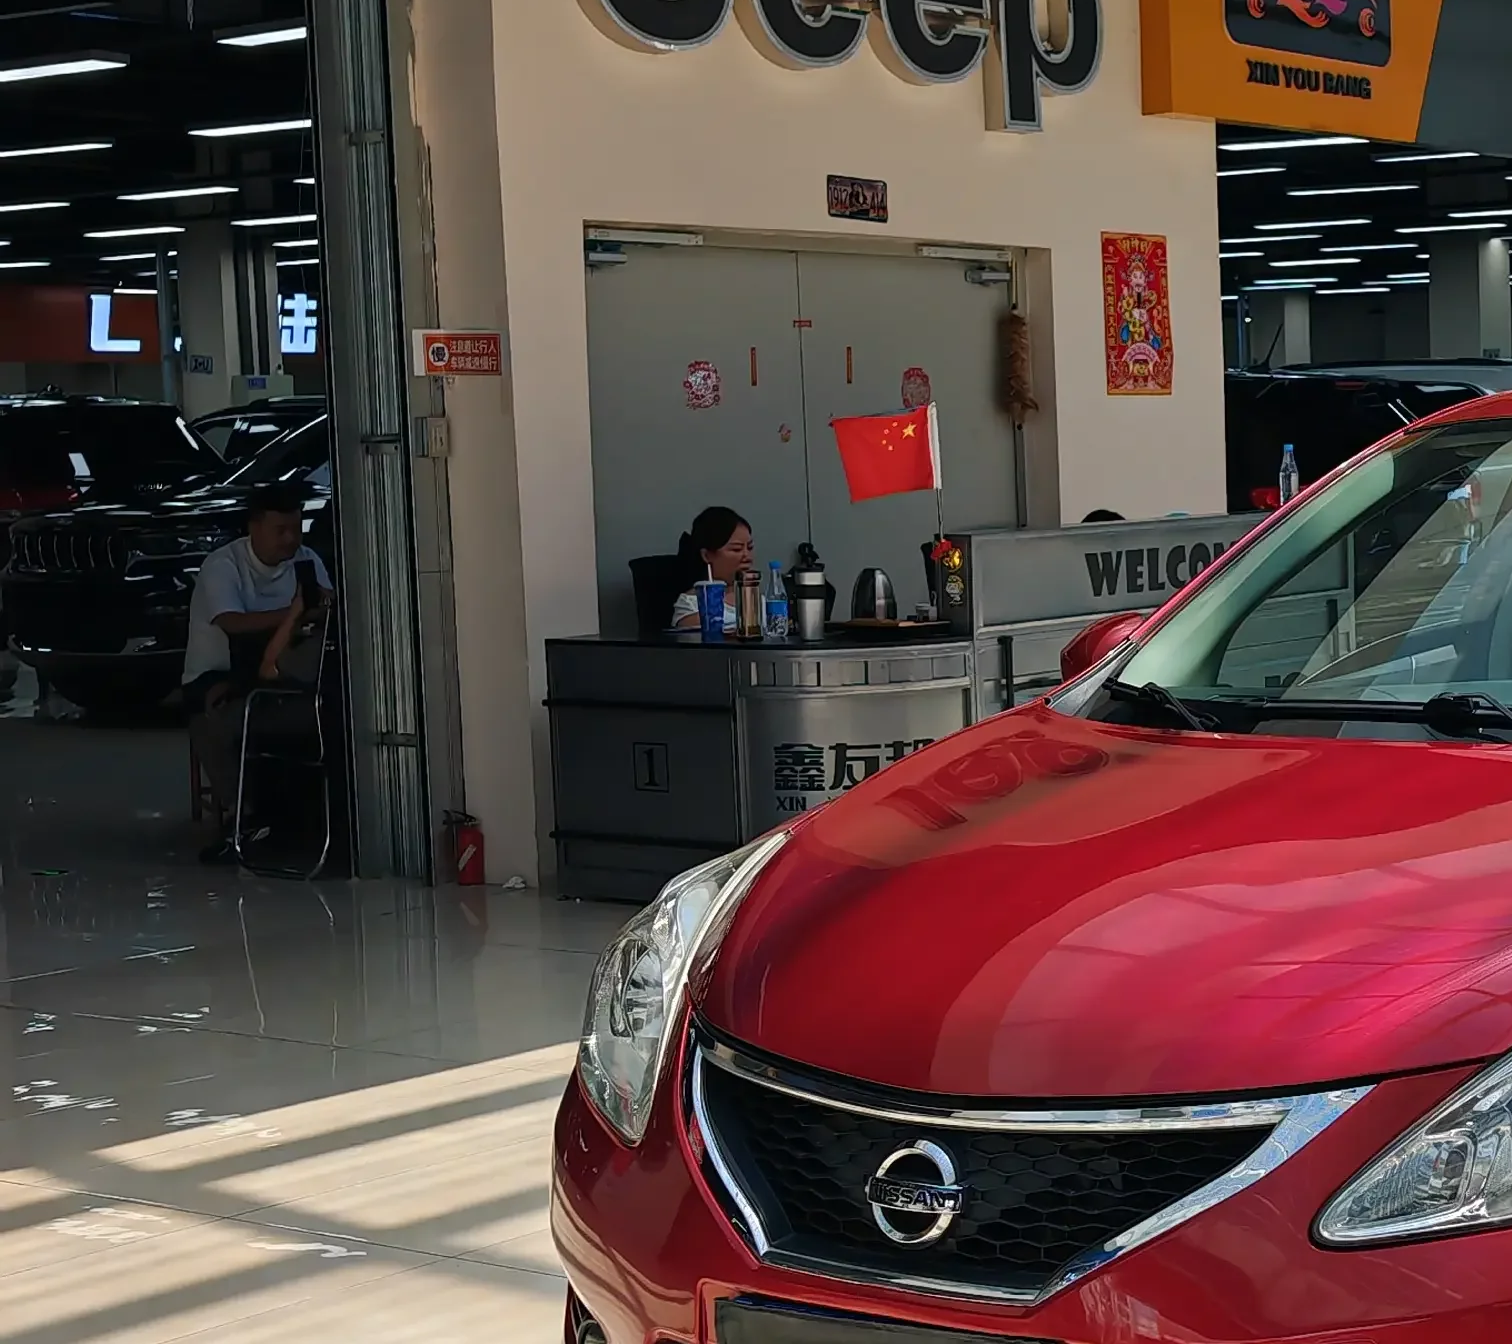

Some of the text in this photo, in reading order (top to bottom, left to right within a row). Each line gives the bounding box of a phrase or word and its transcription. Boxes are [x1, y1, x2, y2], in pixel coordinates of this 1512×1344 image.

[1246, 58, 1372, 101] XIN YOU BANG
[643, 747, 660, 787] 1
[776, 796, 808, 812] XIN
